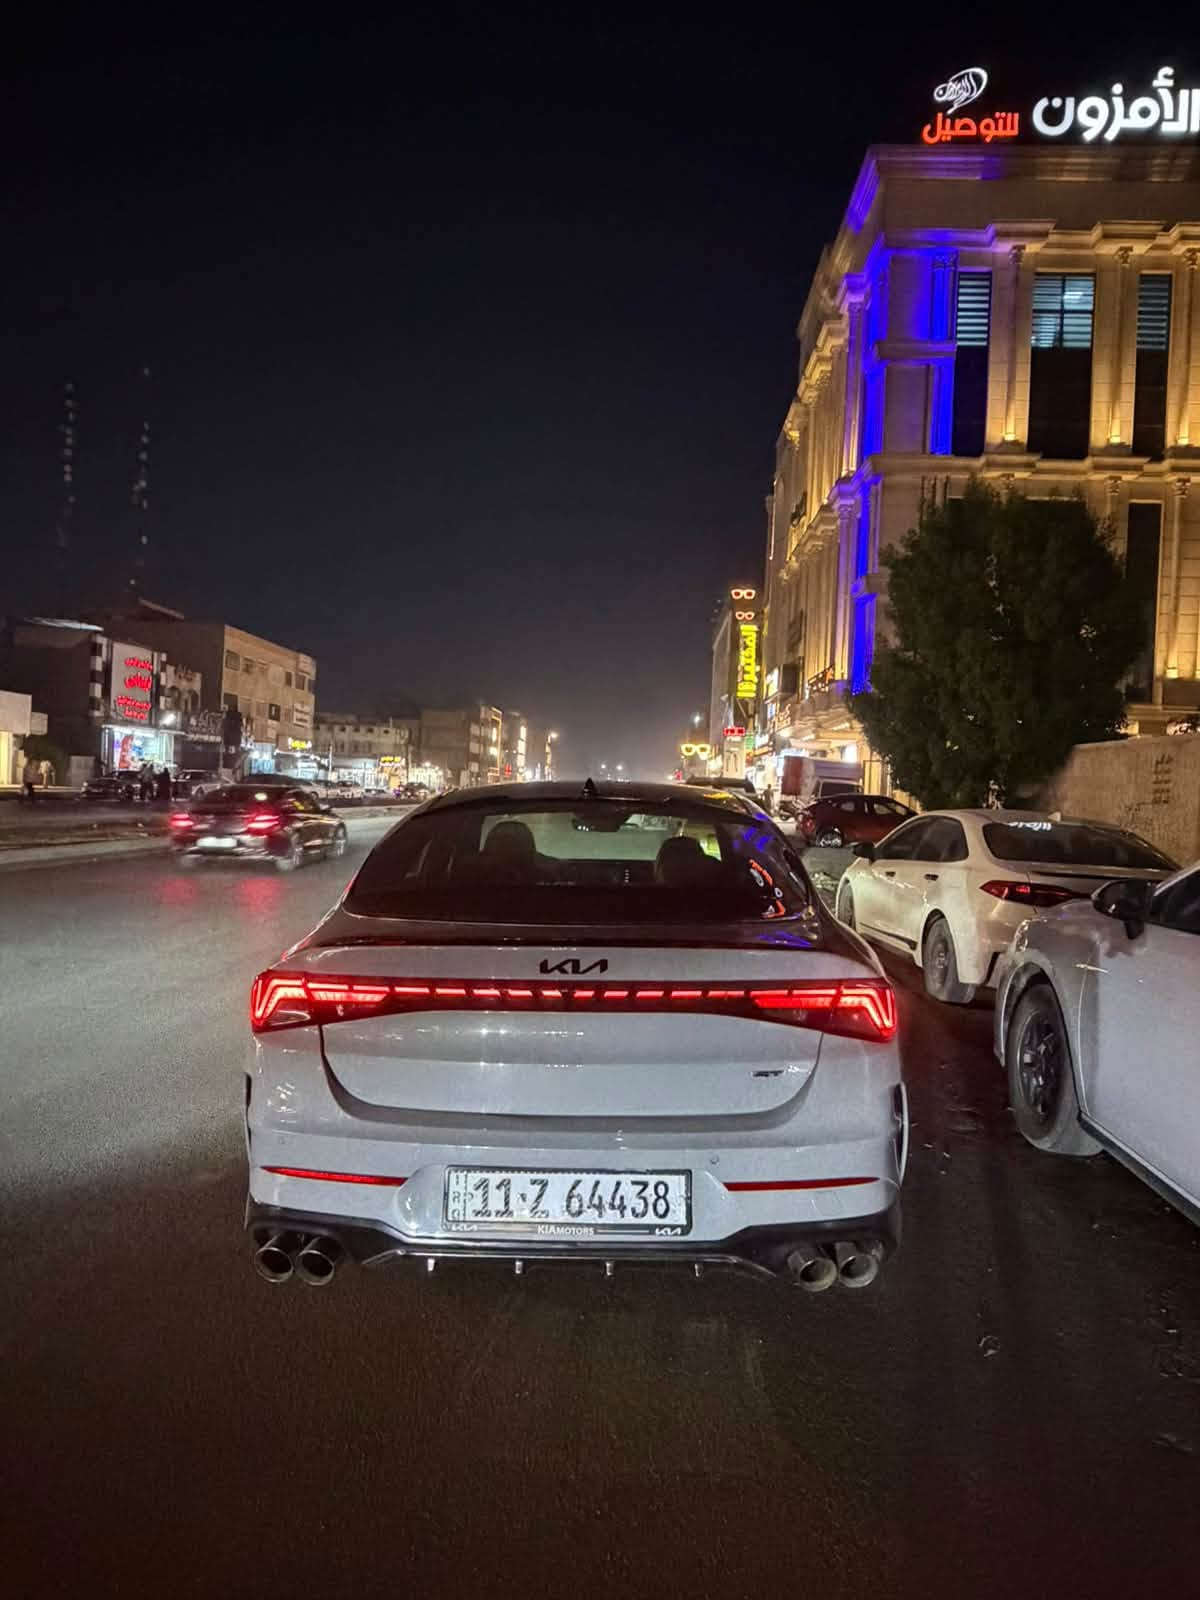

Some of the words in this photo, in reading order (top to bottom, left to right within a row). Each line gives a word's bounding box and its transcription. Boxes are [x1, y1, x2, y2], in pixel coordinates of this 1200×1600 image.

[1032, 66, 1200, 142] الأمزون
[922, 112, 1020, 144] للتوصيل
[539, 958, 608, 975] KIA
[566, 1179, 670, 1219] 64438
